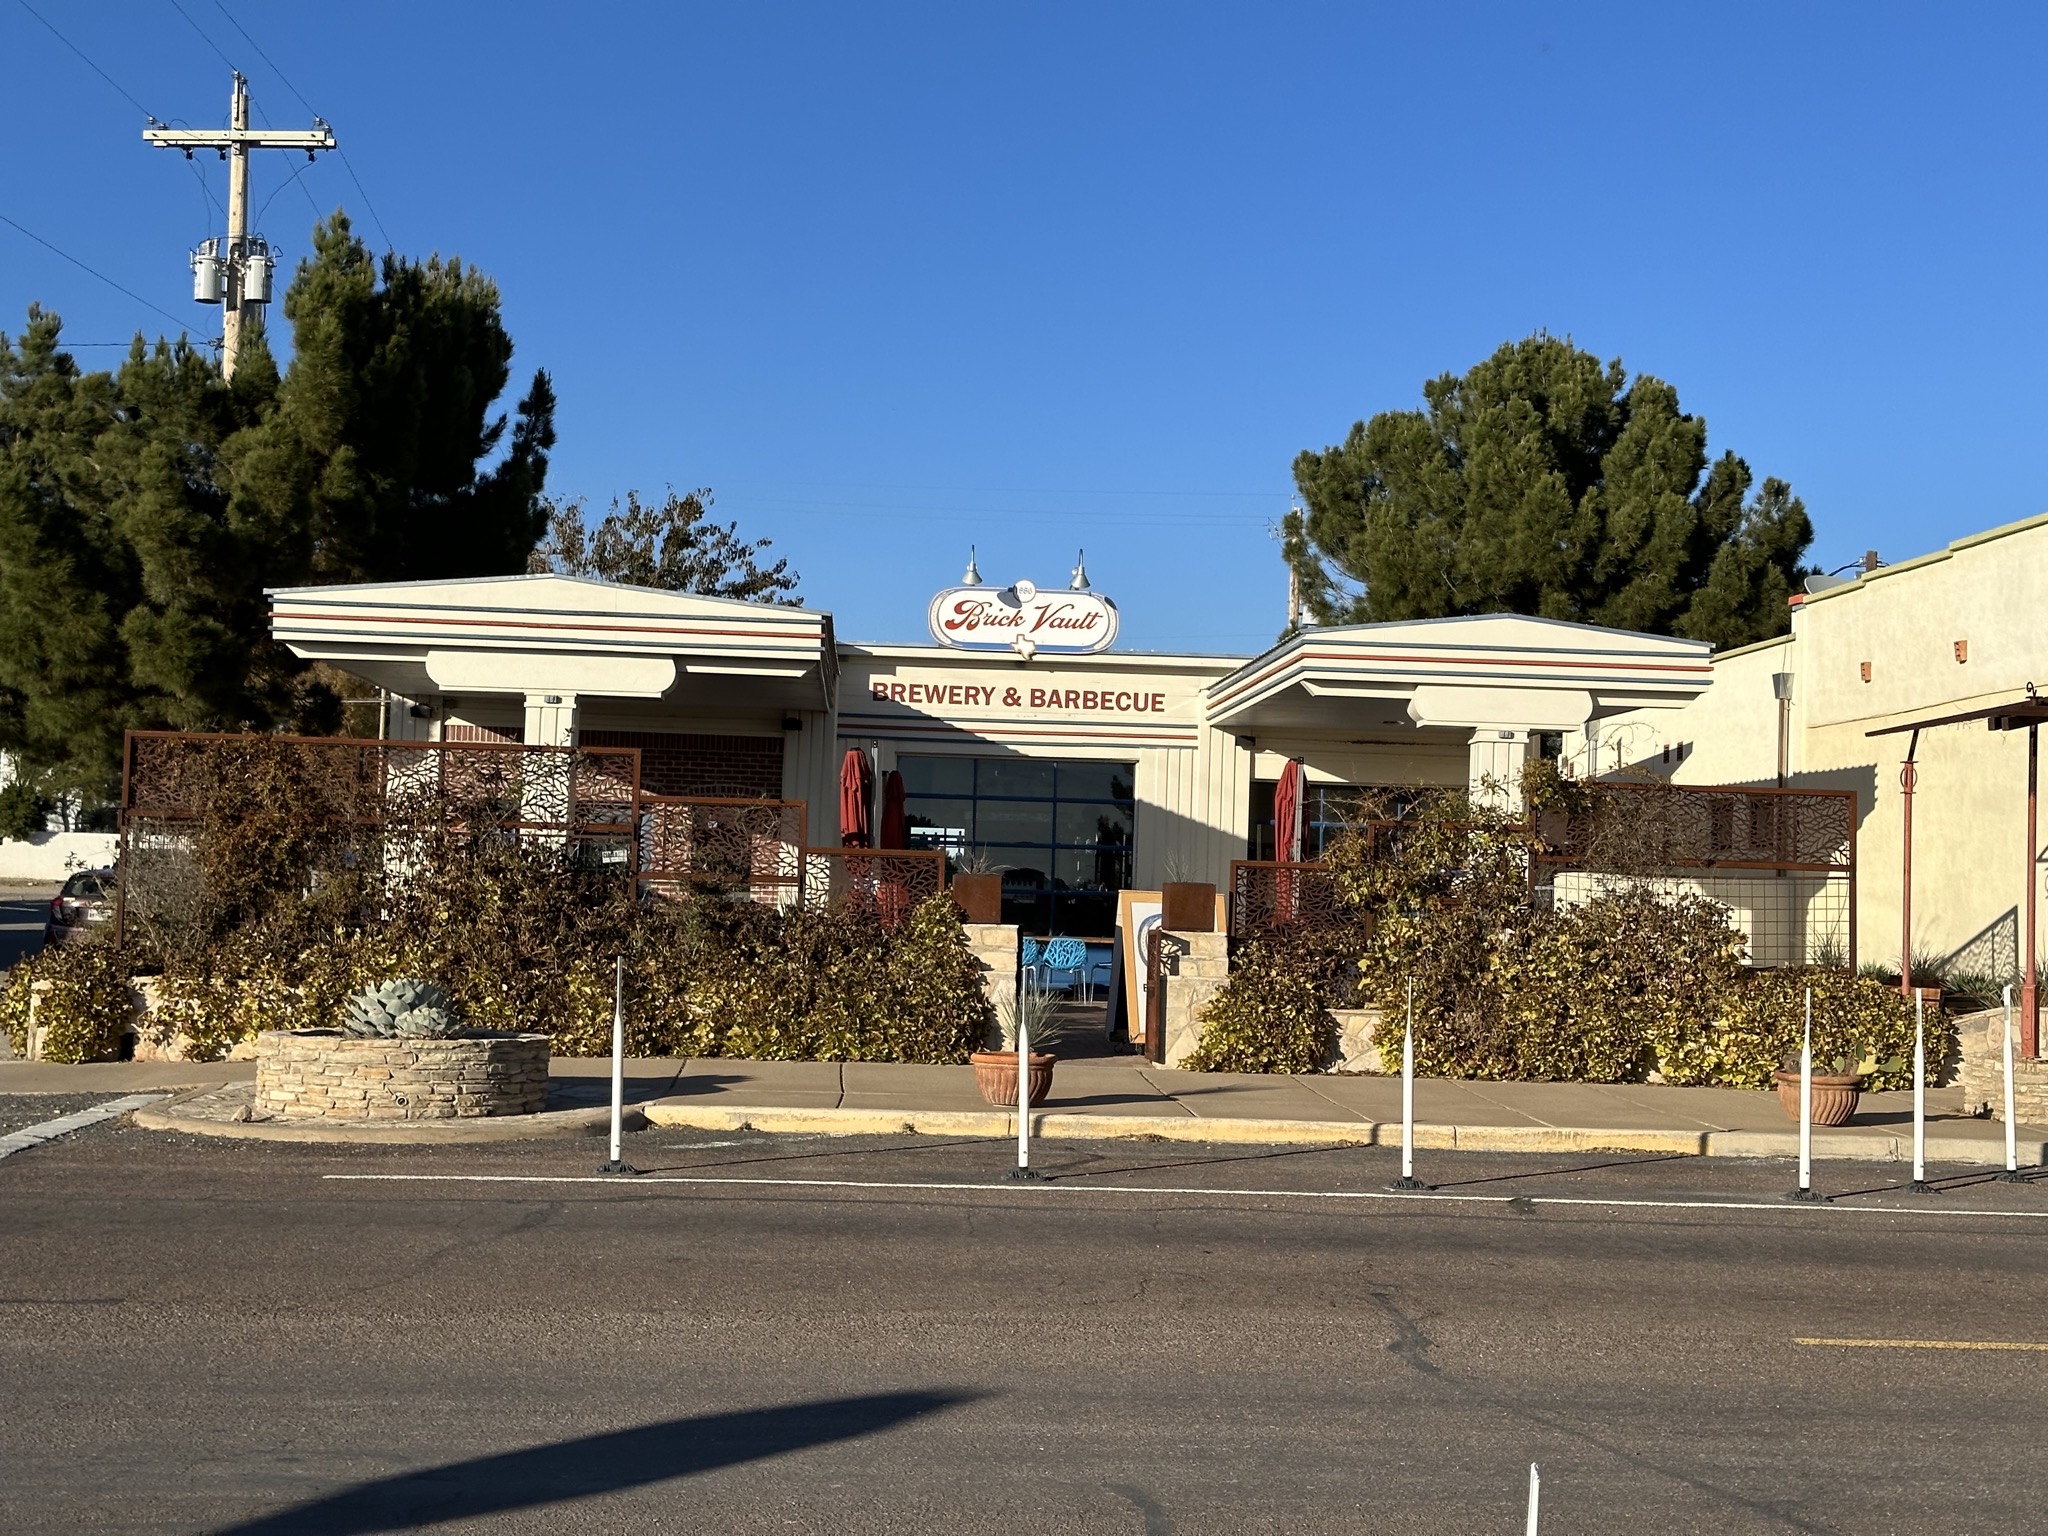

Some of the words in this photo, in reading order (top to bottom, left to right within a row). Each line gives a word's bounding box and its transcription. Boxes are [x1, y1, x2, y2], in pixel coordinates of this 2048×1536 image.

[945, 600, 1026, 631] Brick
[1029, 603, 1104, 633] Vault
[872, 682, 996, 706] BREWERY
[1002, 686, 1022, 707] &
[1030, 688, 1166, 713] BARBECUE
